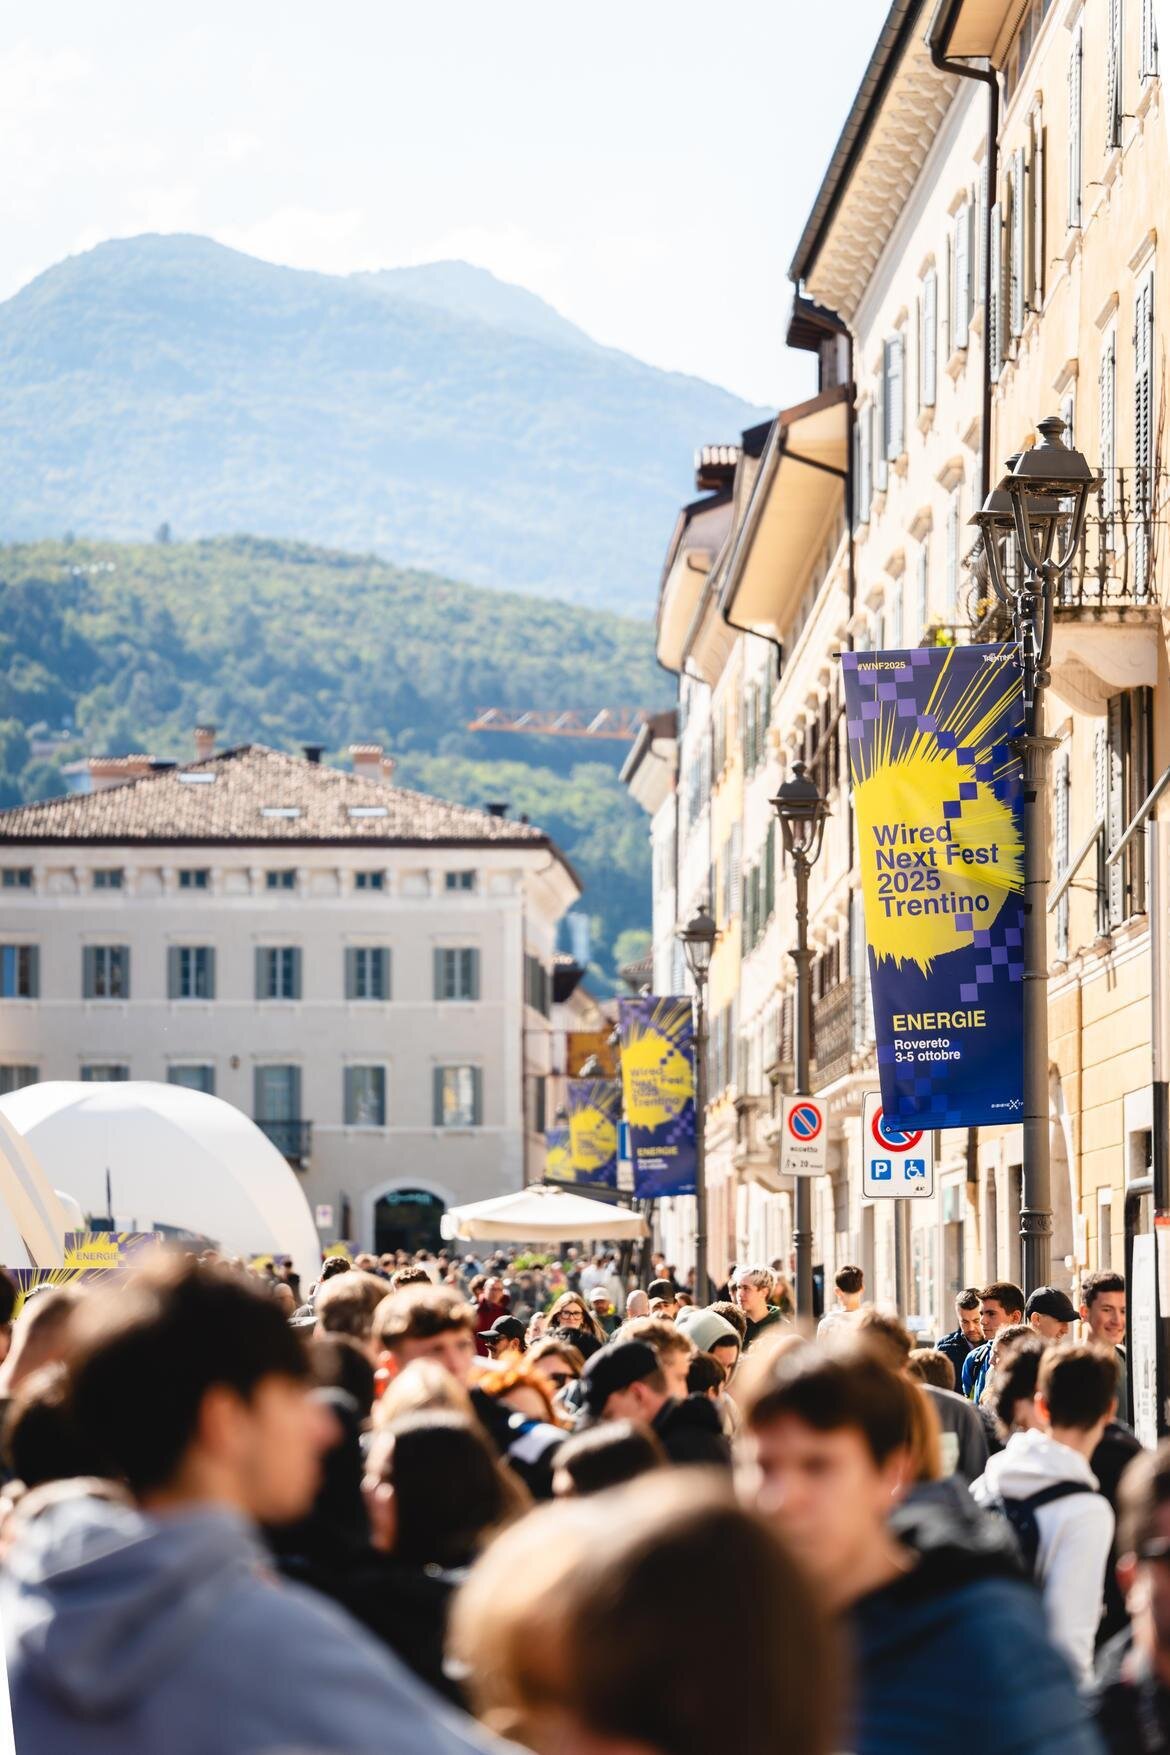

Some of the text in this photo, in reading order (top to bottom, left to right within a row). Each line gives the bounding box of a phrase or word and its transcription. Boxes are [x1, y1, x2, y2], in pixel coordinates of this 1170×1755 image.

[857, 661, 906, 671] #WNF2025
[872, 820, 952, 847] Wired
[876, 843, 999, 870] Next Fest
[877, 869, 941, 895] 2025
[878, 891, 990, 917] Trentino
[892, 1010, 987, 1032] ENERGIE
[894, 1038, 950, 1051] Rovereto
[895, 1049, 961, 1062] 3-5 ottobre
[875, 1162, 888, 1178] P
[76, 1251, 120, 1261] ENERGIE
